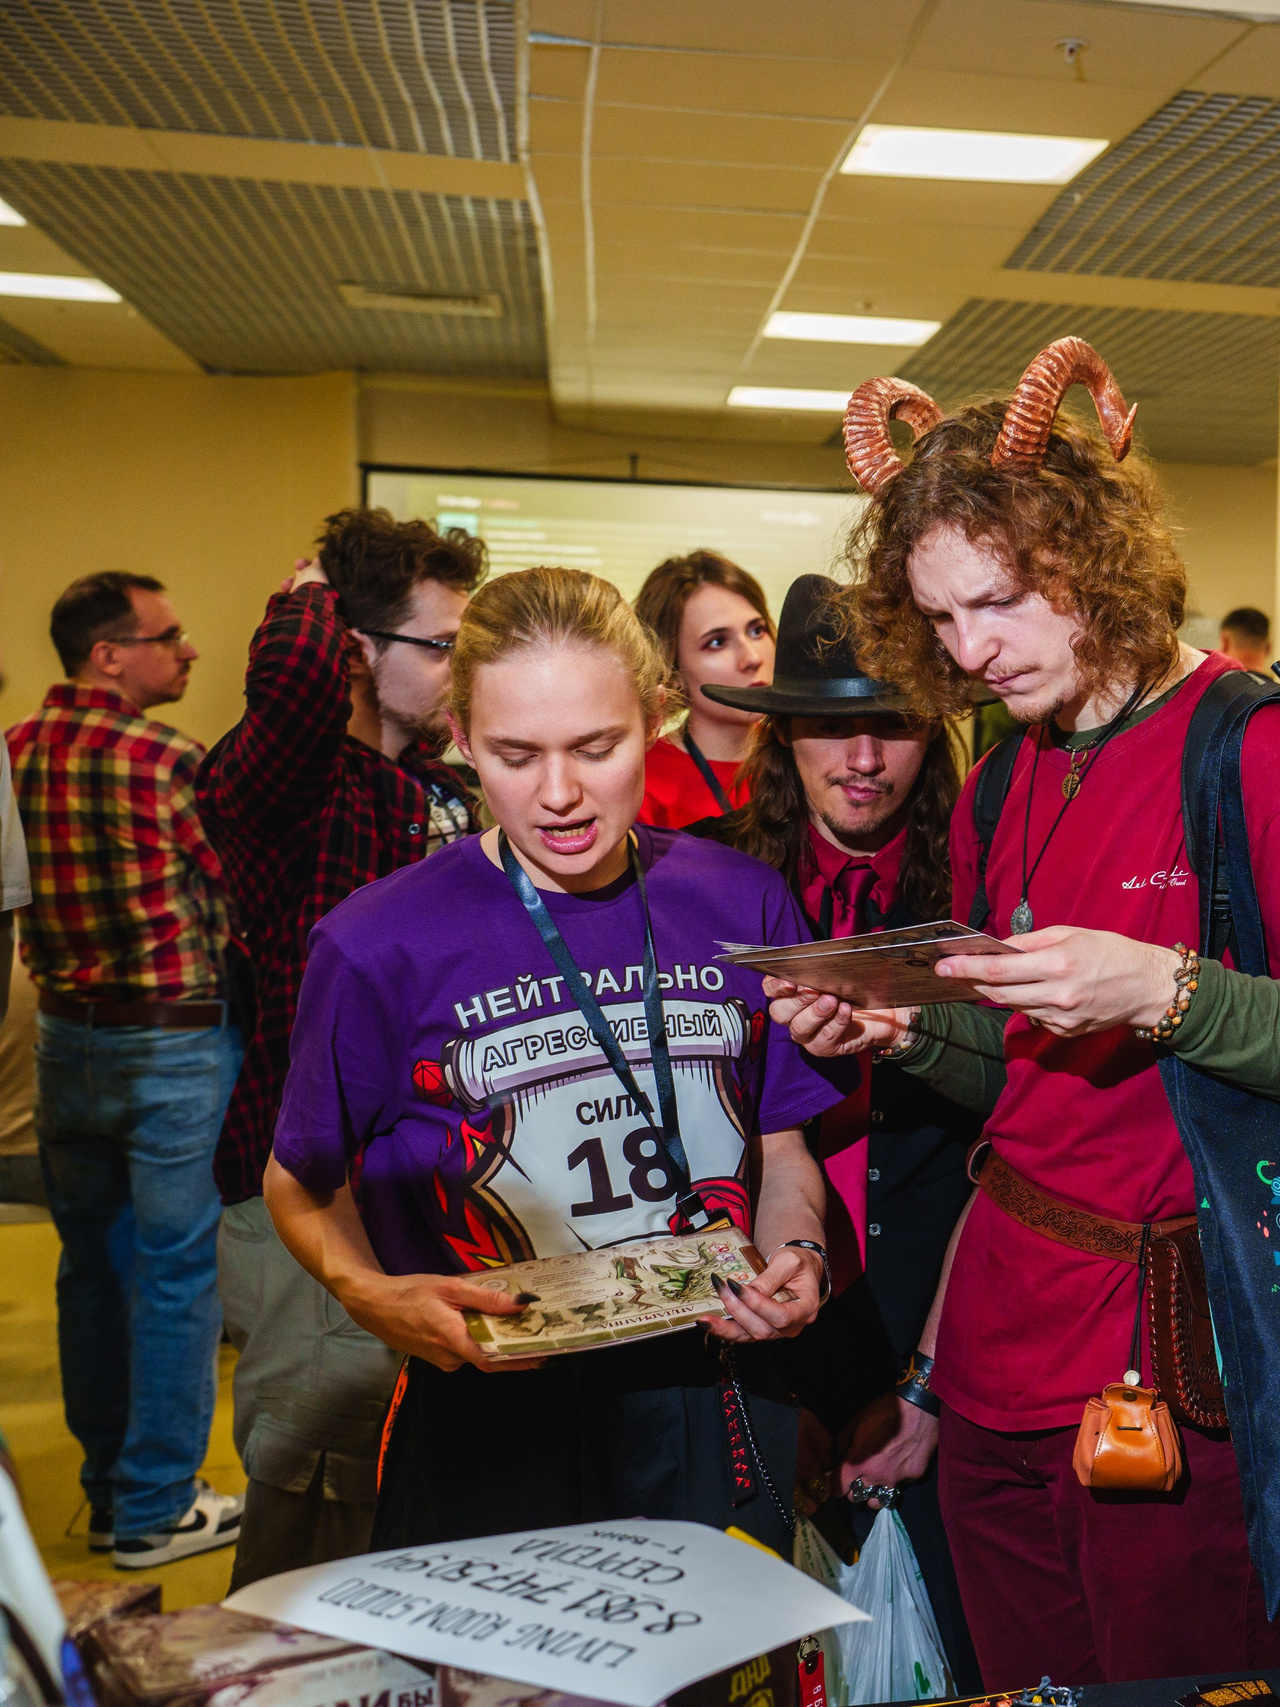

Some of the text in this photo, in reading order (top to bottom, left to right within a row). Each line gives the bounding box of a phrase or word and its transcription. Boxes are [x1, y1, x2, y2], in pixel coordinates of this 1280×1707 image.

[567, 1126, 678, 1217] 18
[503, 1622, 637, 1669] LIVING
[642, 1610, 702, 1635] 8
